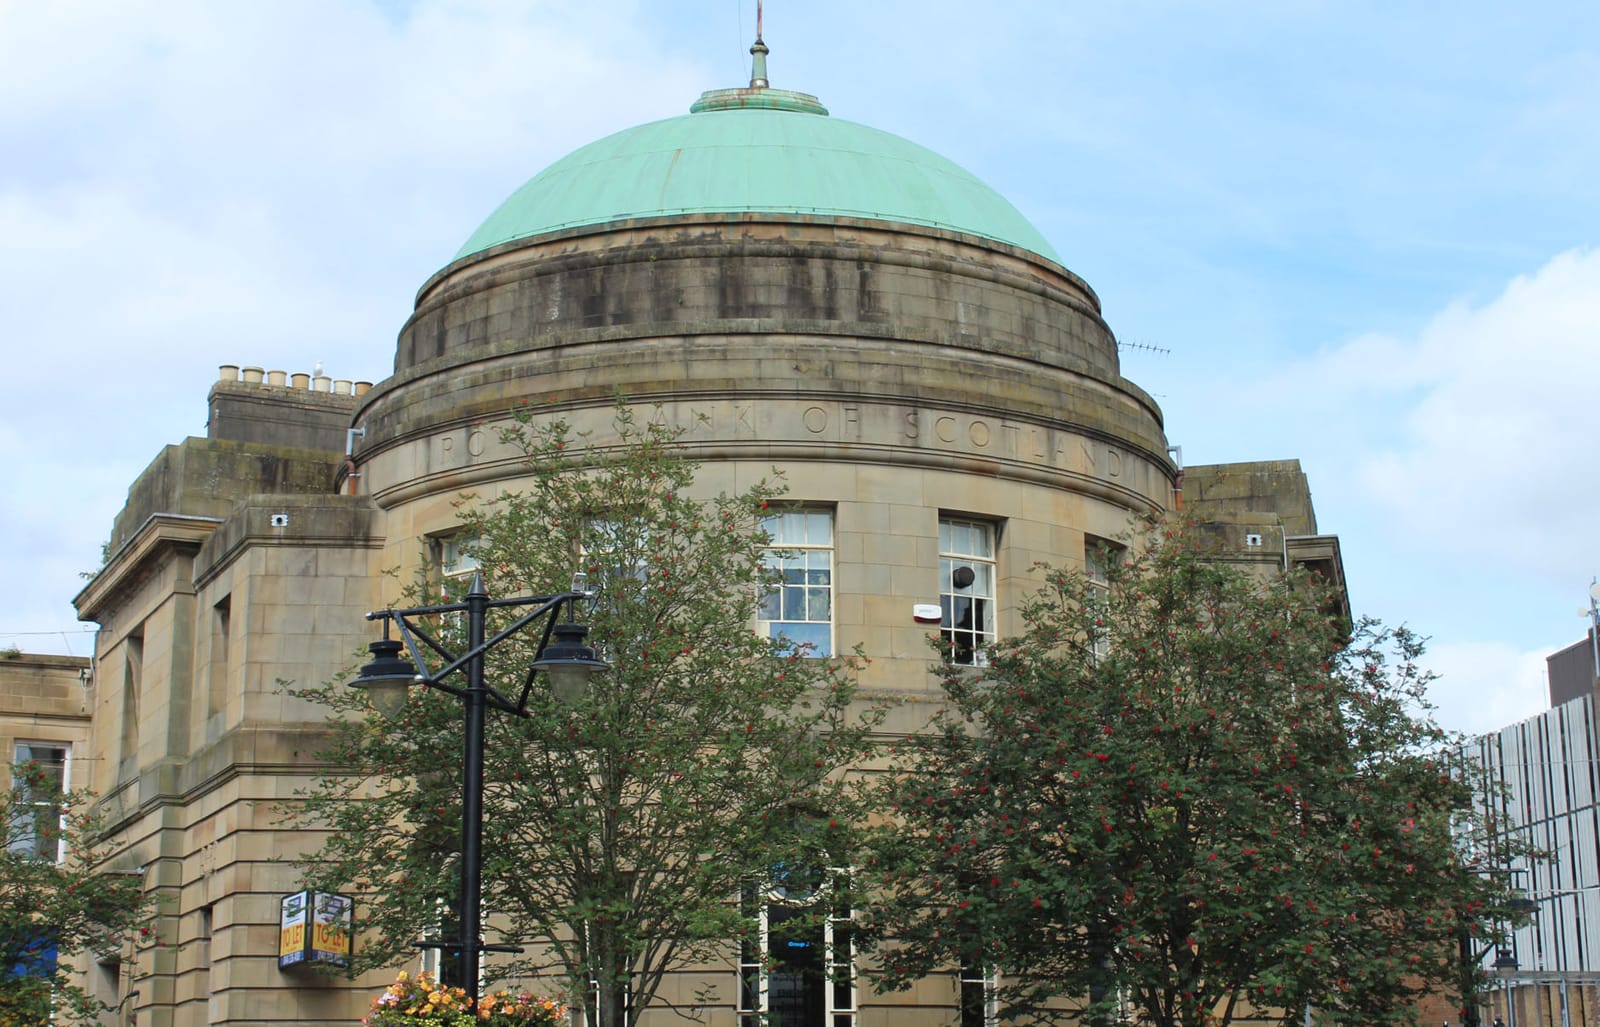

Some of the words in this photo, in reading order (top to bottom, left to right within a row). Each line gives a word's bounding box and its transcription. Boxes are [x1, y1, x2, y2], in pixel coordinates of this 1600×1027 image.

[803, 406, 862, 439] OF
[904, 411, 1122, 478] SCOTLAND
[293, 924, 303, 945] LET
[317, 923, 330, 944] TO
